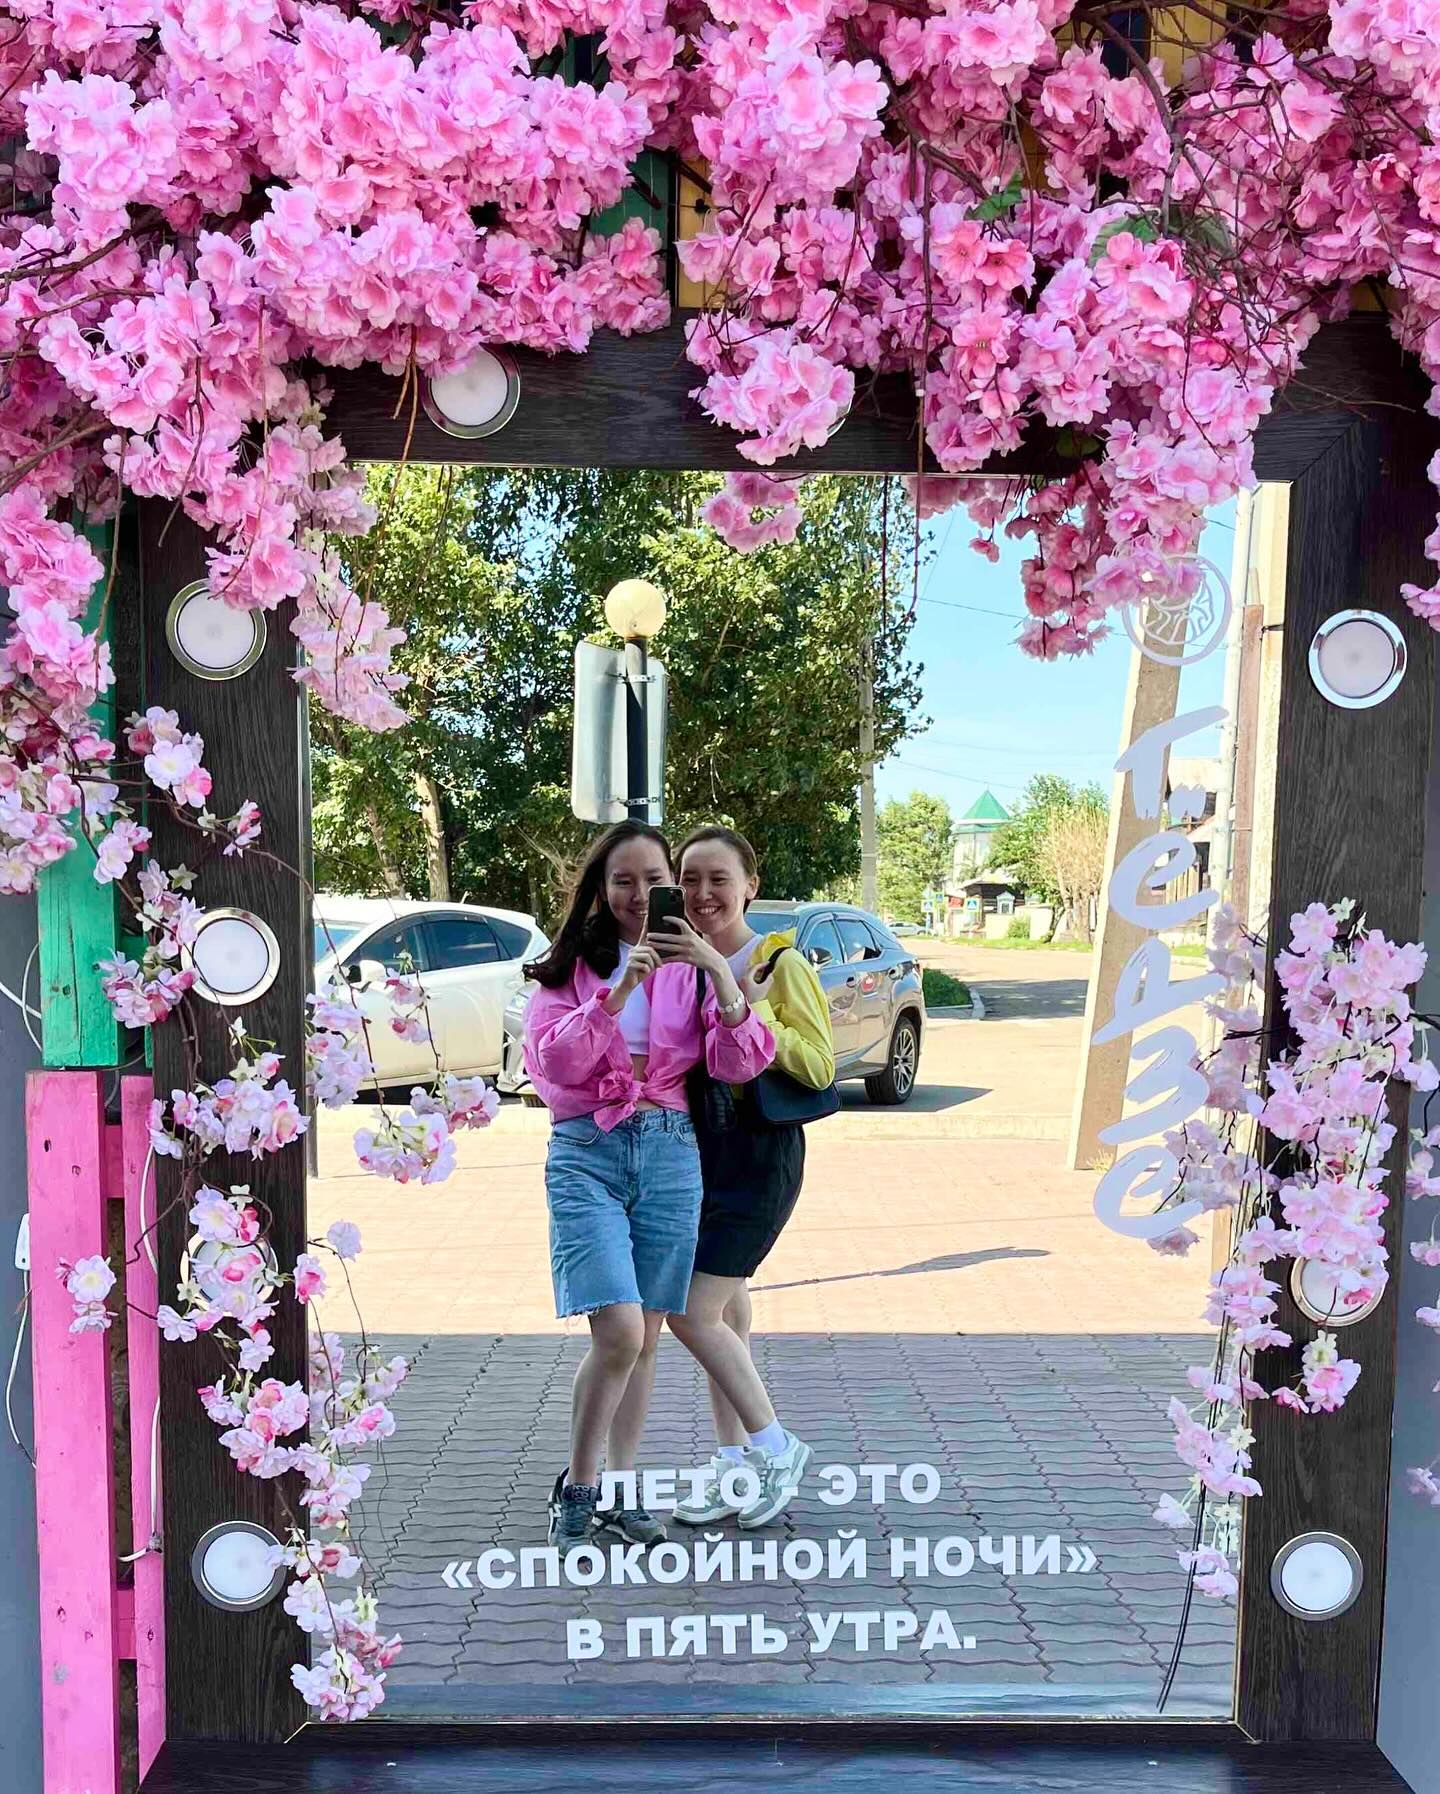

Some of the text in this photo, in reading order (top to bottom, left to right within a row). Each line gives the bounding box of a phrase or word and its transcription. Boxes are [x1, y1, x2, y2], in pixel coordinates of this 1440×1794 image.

[597, 1469, 761, 1512] ЛЕТО
[818, 1464, 941, 1506] ЭТО
[441, 1529, 1098, 1588] «СПОКОЙНОЙ НОЧИ»
[567, 1608, 977, 1659] В ПЯТЬ УТРА.
